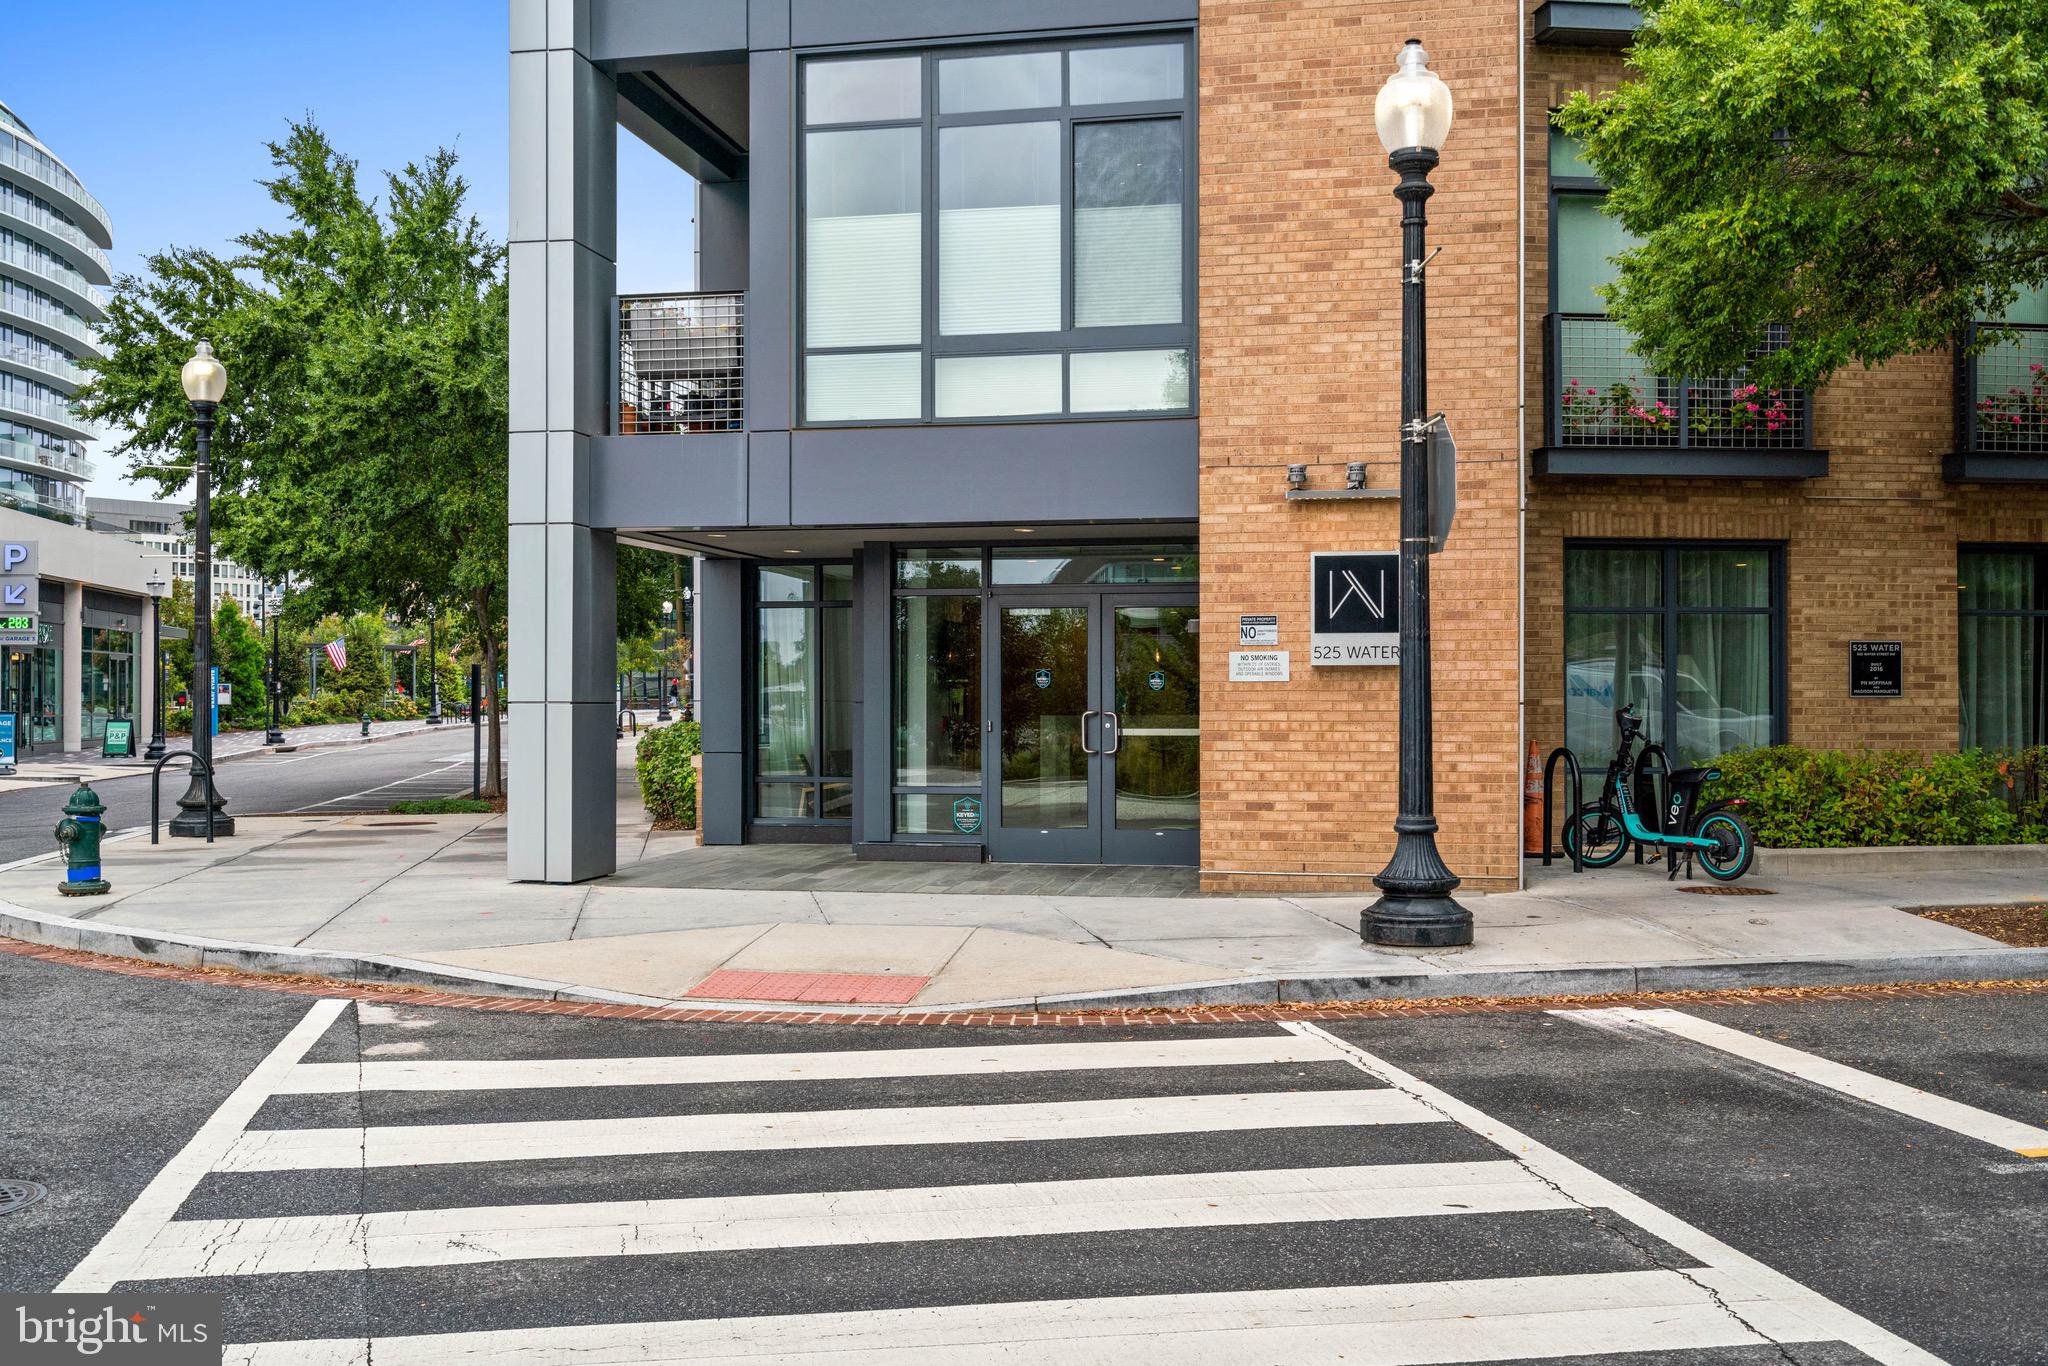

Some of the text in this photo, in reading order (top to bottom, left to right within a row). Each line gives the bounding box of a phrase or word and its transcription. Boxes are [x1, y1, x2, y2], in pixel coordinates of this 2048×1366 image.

[4, 544, 27, 571] P
[1241, 626, 1256, 639] NO
[1314, 645, 1400, 659] 525 WATER
[109, 732, 126, 740] P&P
